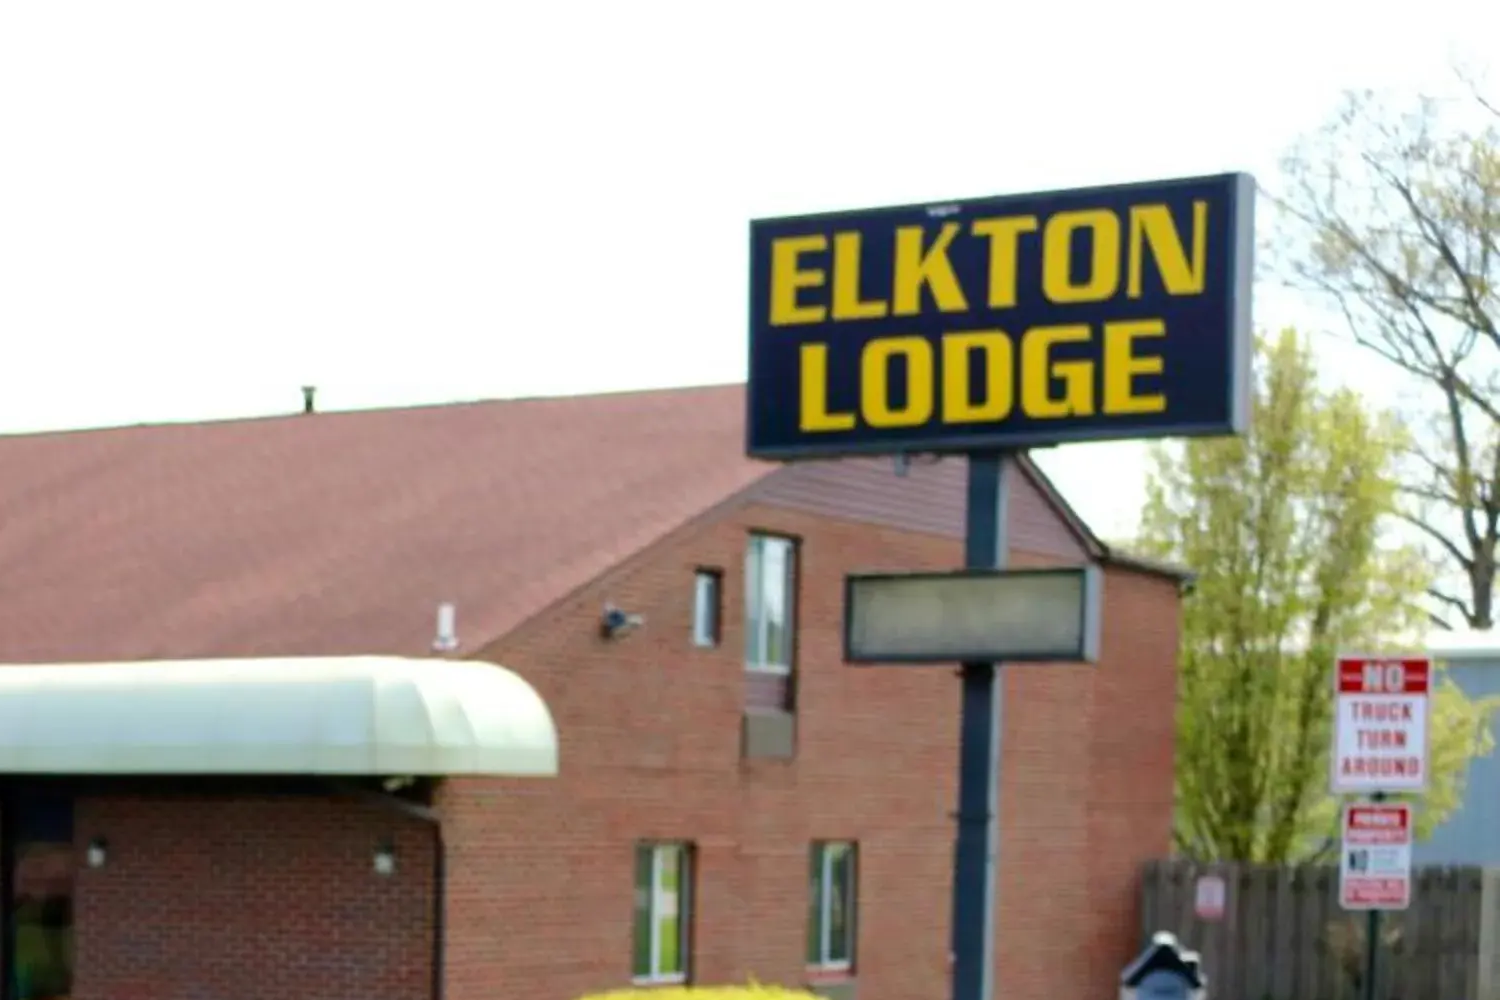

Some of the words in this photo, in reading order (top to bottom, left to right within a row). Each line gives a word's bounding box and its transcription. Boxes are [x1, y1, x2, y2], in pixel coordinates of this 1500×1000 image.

[769, 201, 1207, 326] ELKTON
[800, 319, 1167, 432] LODGE
[1362, 661, 1404, 692] NO
[1349, 701, 1413, 722] TRUCK
[1357, 729, 1406, 750] TURN
[1342, 756, 1419, 777] AROUND
